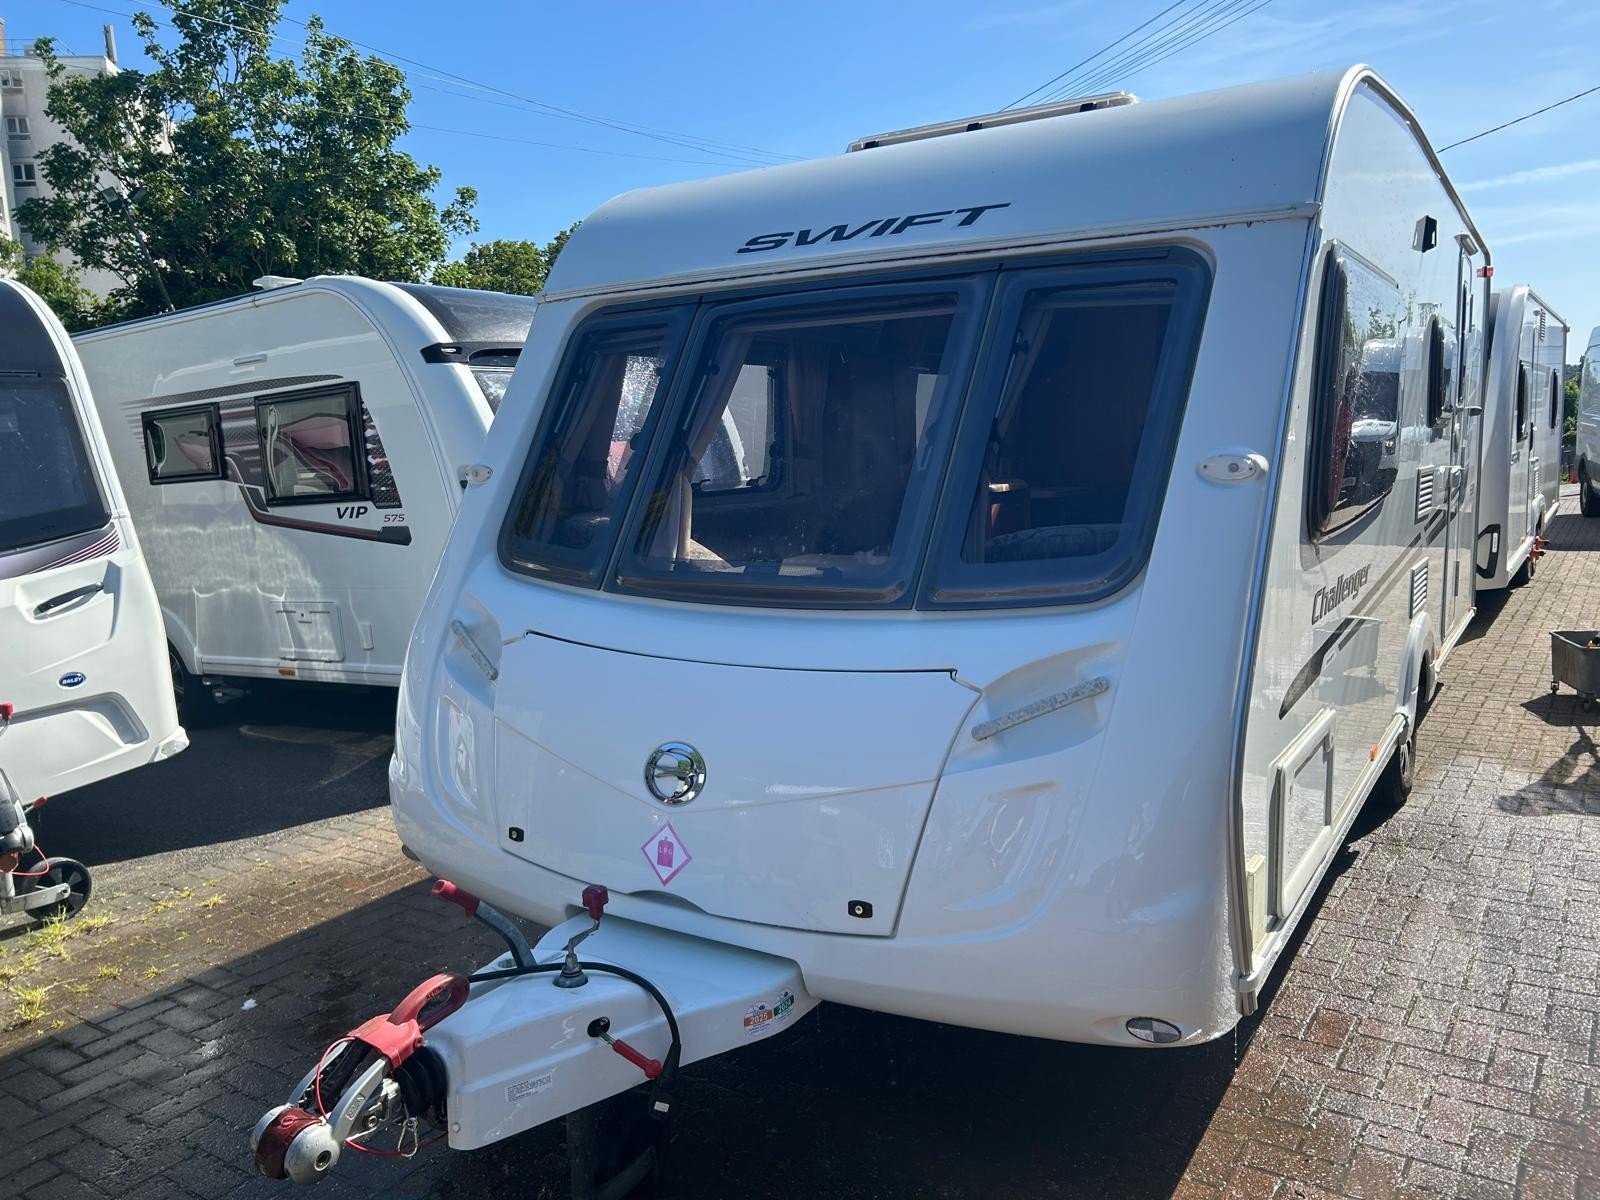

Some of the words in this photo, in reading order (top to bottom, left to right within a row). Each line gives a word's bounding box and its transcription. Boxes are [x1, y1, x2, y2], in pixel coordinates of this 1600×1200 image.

[737, 202, 1012, 254] SWIFT
[336, 506, 369, 520] VIP
[383, 513, 405, 523] 575
[1311, 563, 1372, 626] Challenger
[659, 847, 673, 856] LPG
